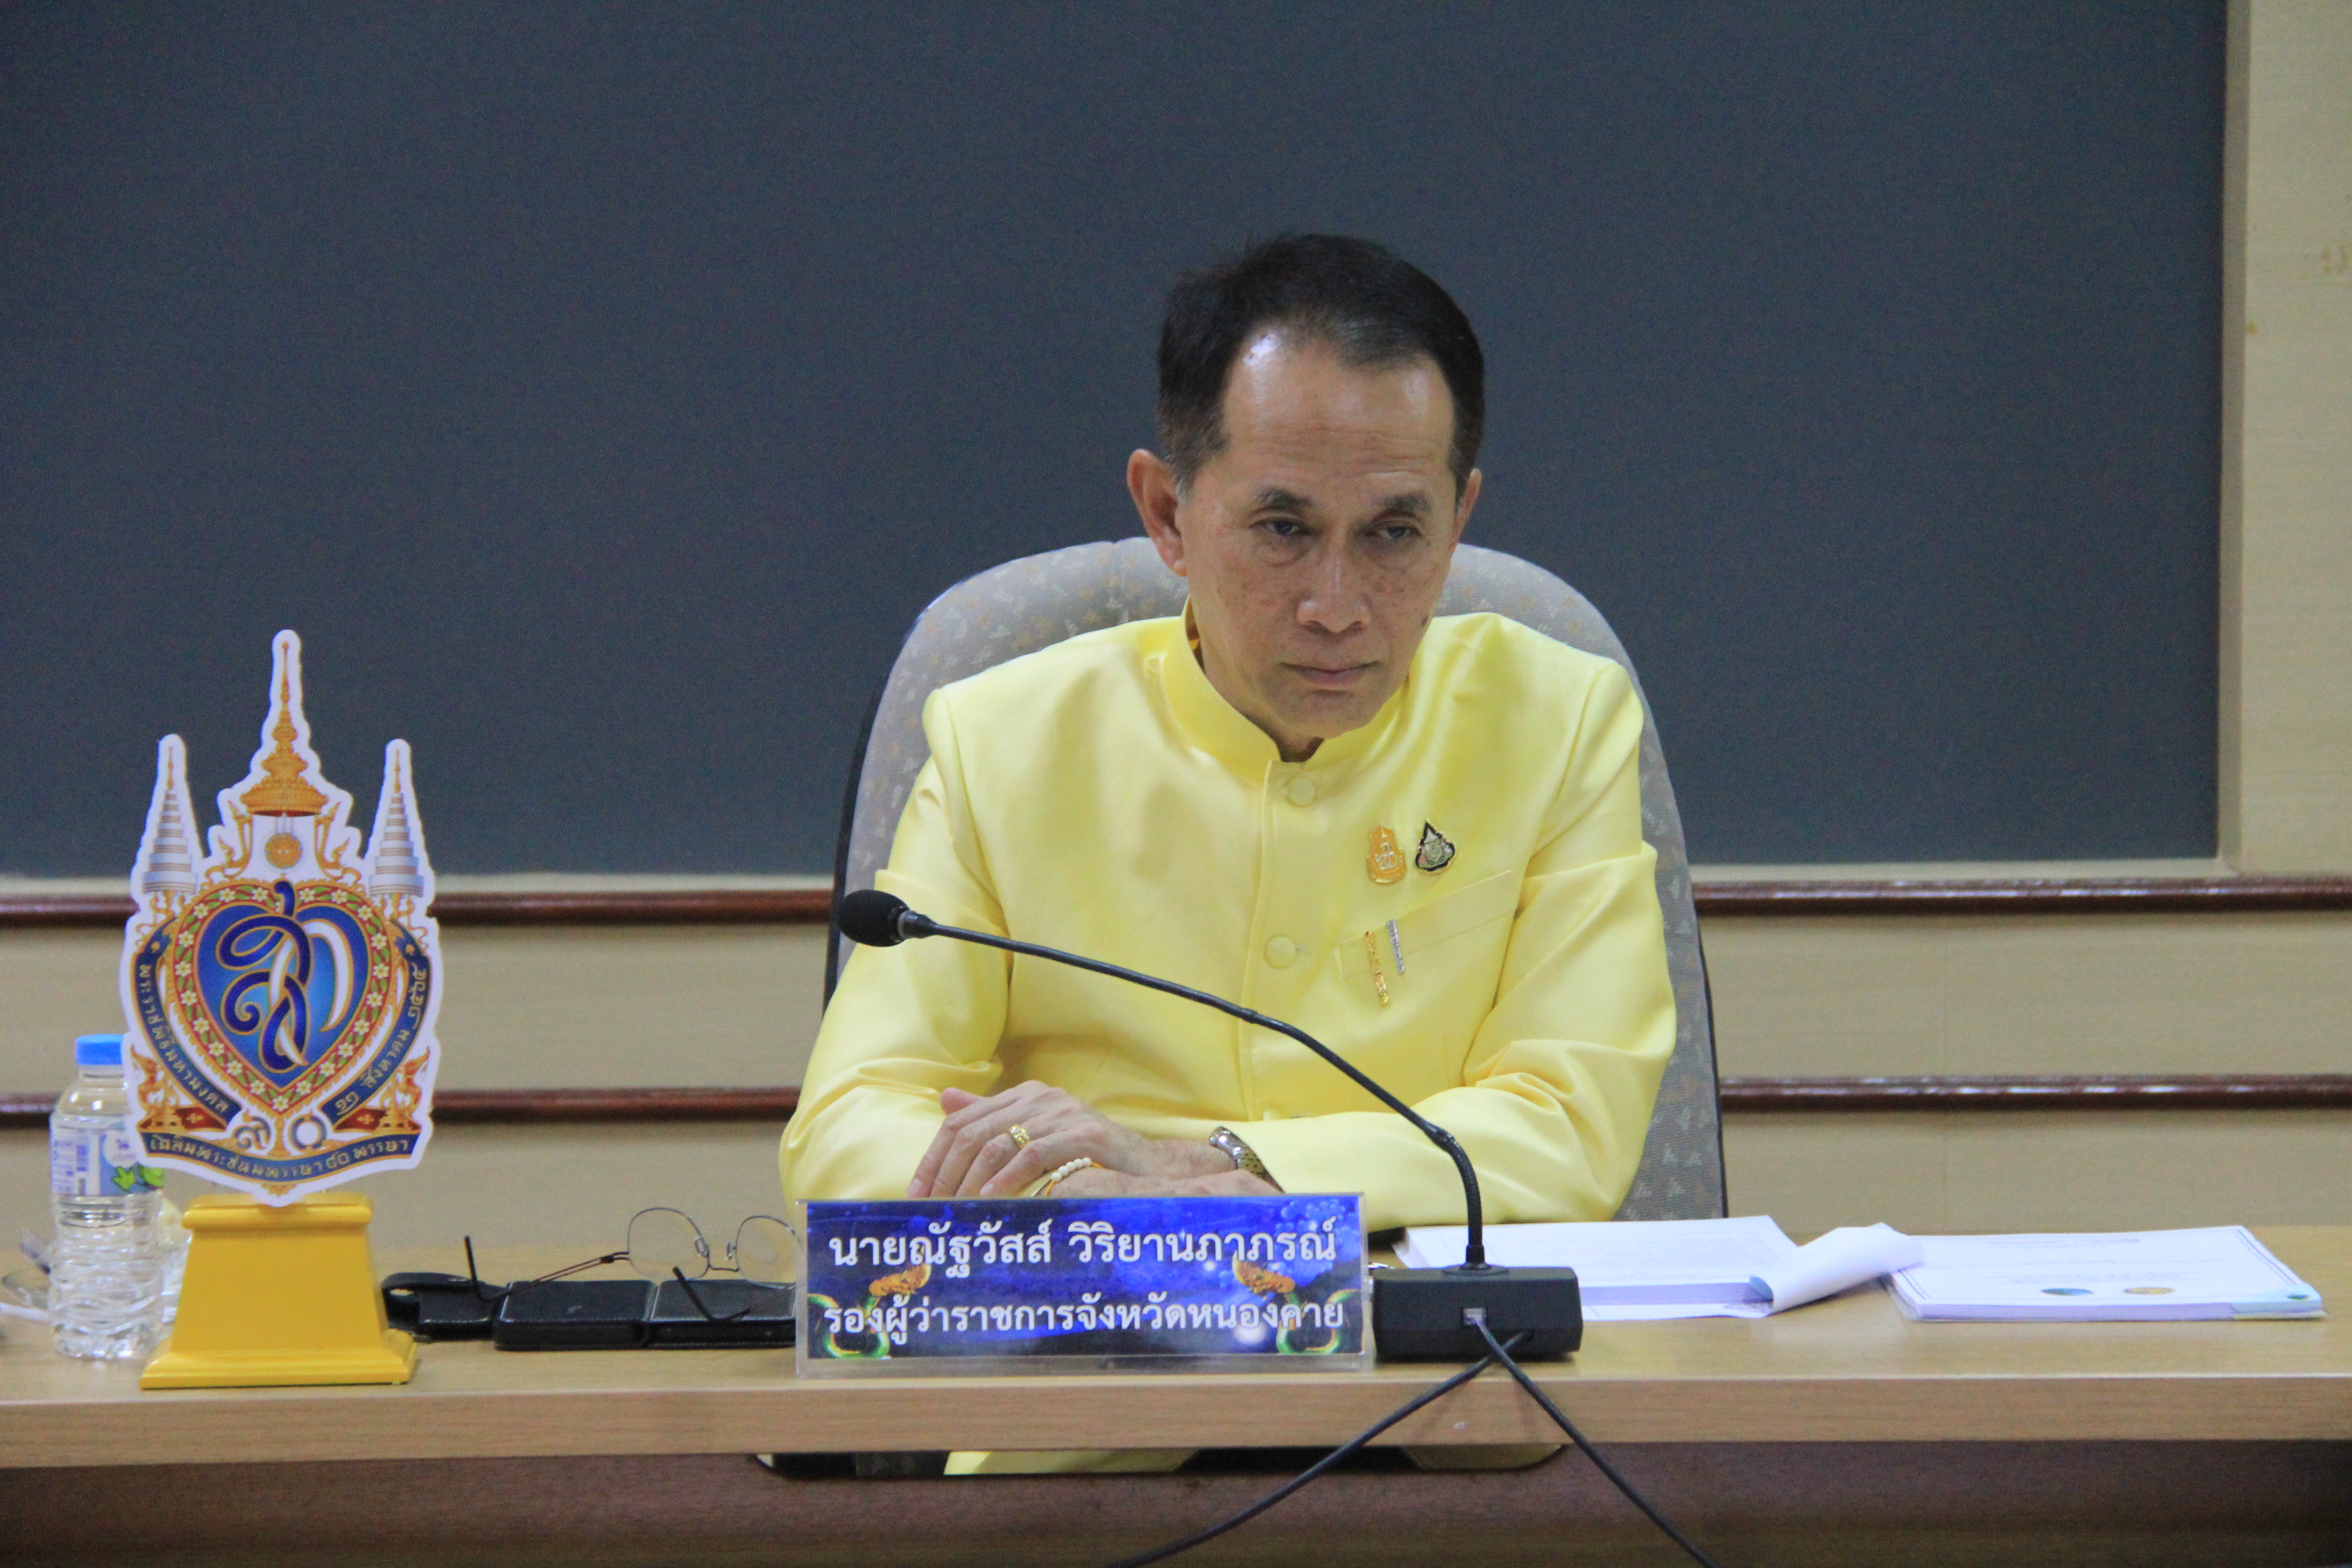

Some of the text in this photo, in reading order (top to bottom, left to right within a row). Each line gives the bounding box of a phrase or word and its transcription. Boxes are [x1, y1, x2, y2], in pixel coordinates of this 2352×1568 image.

[353, 1138, 409, 1160] พรรษา
[828, 1216, 1337, 1279] นายณัฐวัสส์ วิริยานภาภรณ์
[823, 1290, 1344, 1346] รองผู้ว่าราชการจังหวัดหนองคาย
